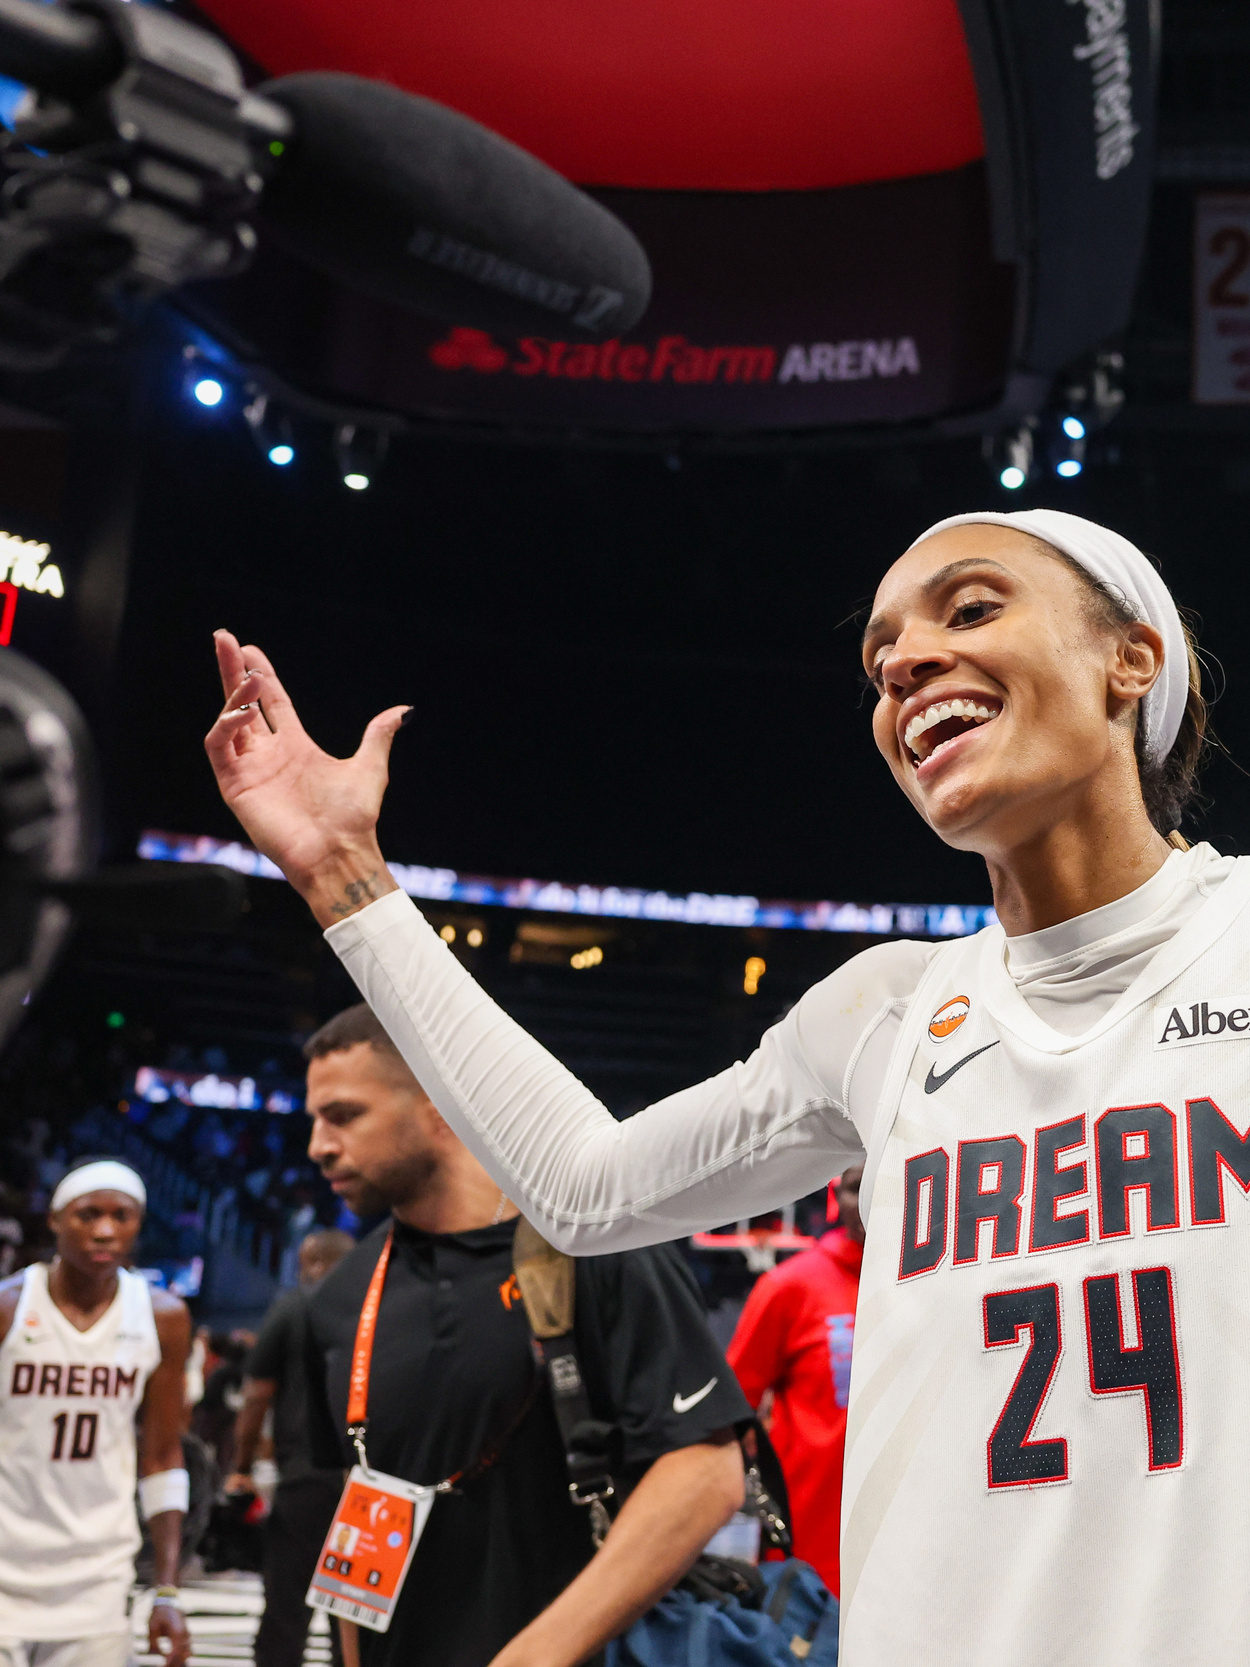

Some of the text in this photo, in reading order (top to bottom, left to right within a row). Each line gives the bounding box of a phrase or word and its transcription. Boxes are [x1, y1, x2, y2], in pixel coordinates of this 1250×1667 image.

[778, 336, 920, 384] ARENA
[11, 1363, 139, 1397] DREAM
[982, 1266, 1185, 1490] 24
[52, 1411, 99, 1461] 10
